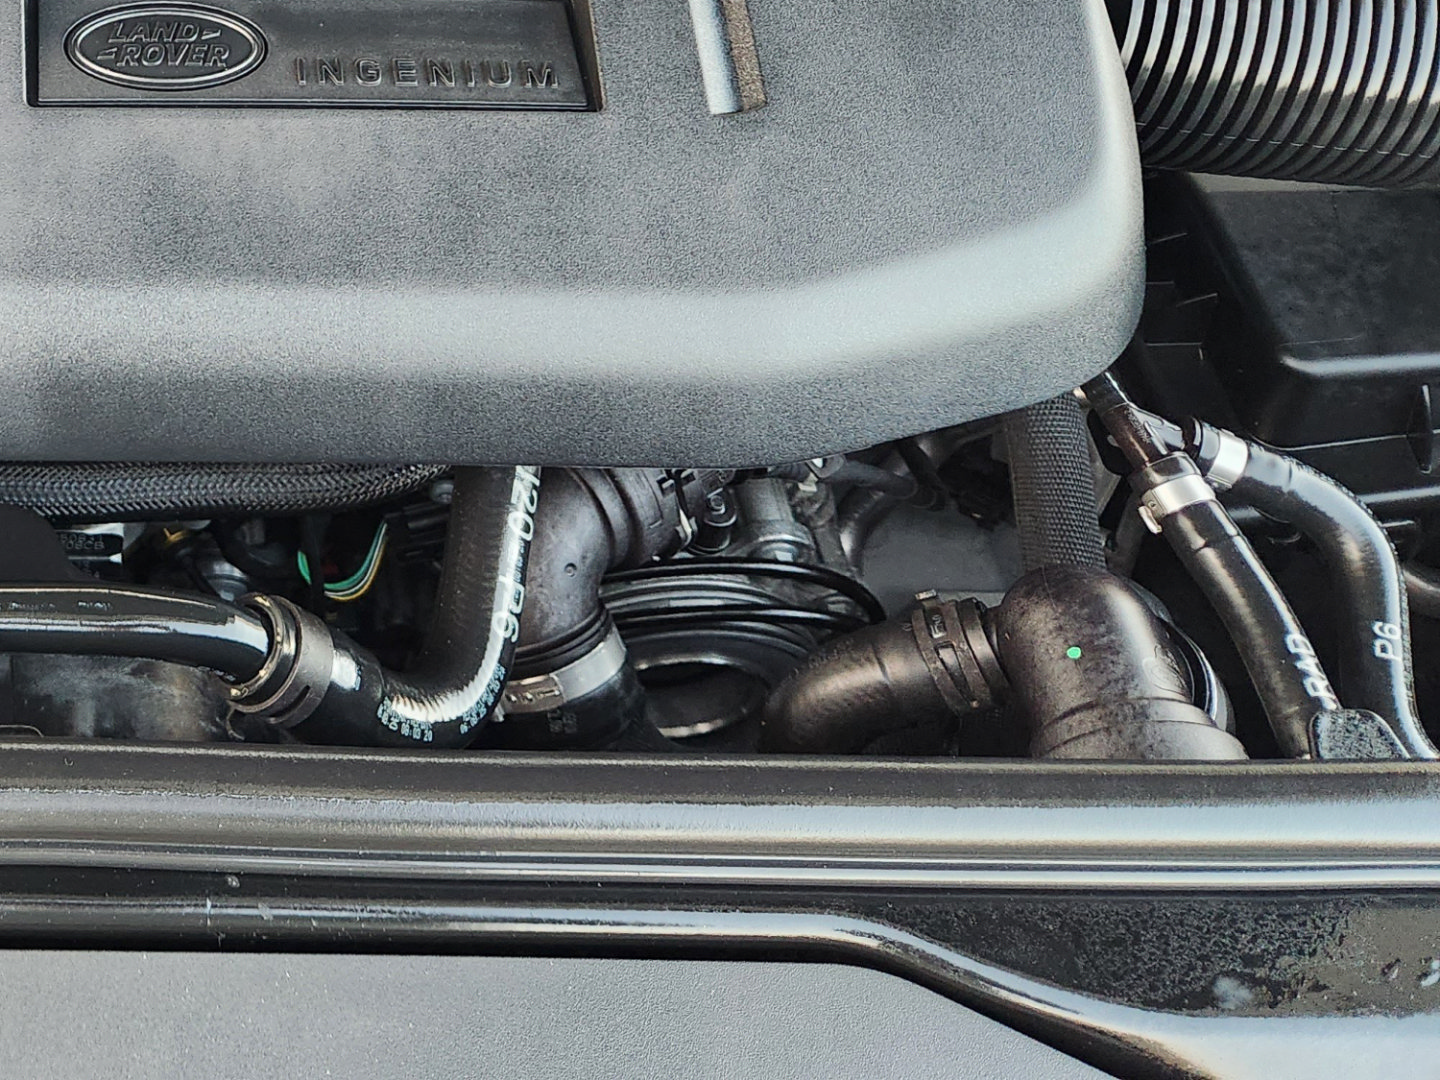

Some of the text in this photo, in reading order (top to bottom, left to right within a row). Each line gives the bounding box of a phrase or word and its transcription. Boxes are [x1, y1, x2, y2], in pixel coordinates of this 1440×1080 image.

[108, 21, 201, 43] LAND
[116, 43, 231, 67] ROVER
[295, 56, 560, 89] INGENIUM
[1372, 620, 1402, 662] P6
